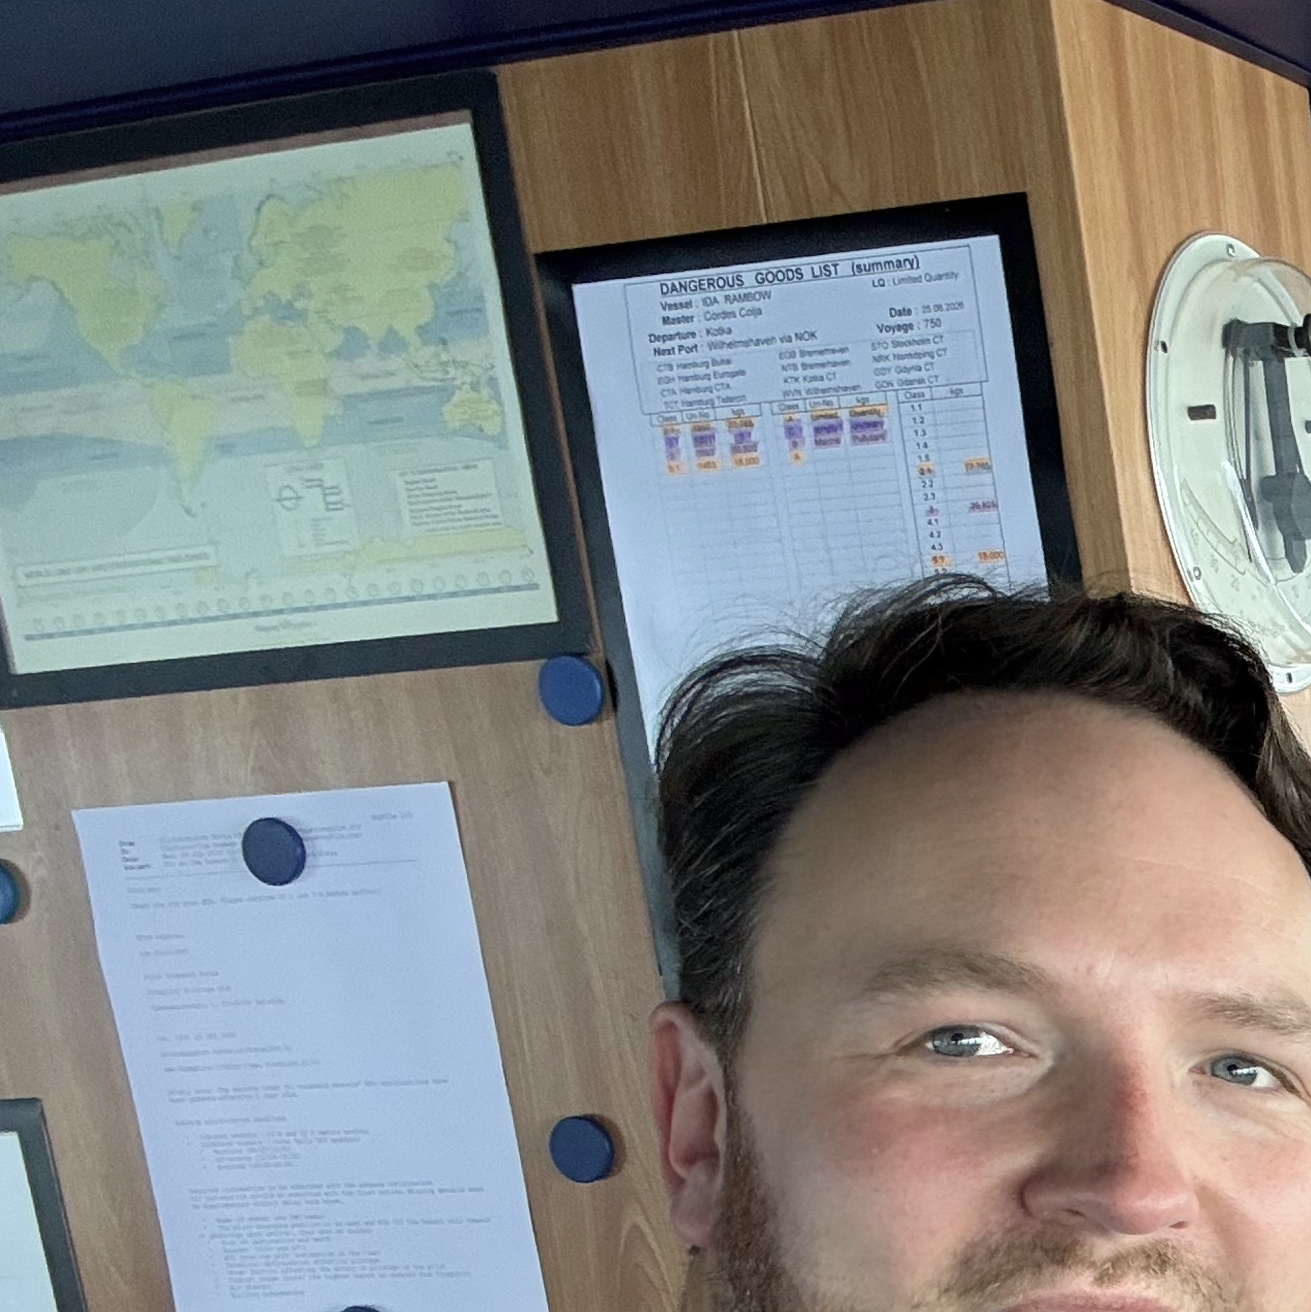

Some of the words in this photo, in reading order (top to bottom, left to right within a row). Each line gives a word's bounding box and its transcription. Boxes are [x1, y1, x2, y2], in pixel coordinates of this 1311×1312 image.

[660, 274, 744, 296] DANGEROUS
[755, 267, 804, 285] GOODS
[811, 263, 840, 279] LIST
[851, 254, 920, 276] (summary)
[660, 299, 694, 312] Vessel
[889, 306, 913, 318] Date
[662, 314, 695, 326] Master
[876, 321, 914, 335] Voyage
[924, 317, 942, 329] 750
[648, 330, 697, 345] Departure
[678, 343, 699, 355] Port
[779, 333, 793, 344] via
[794, 330, 818, 342] NOK
